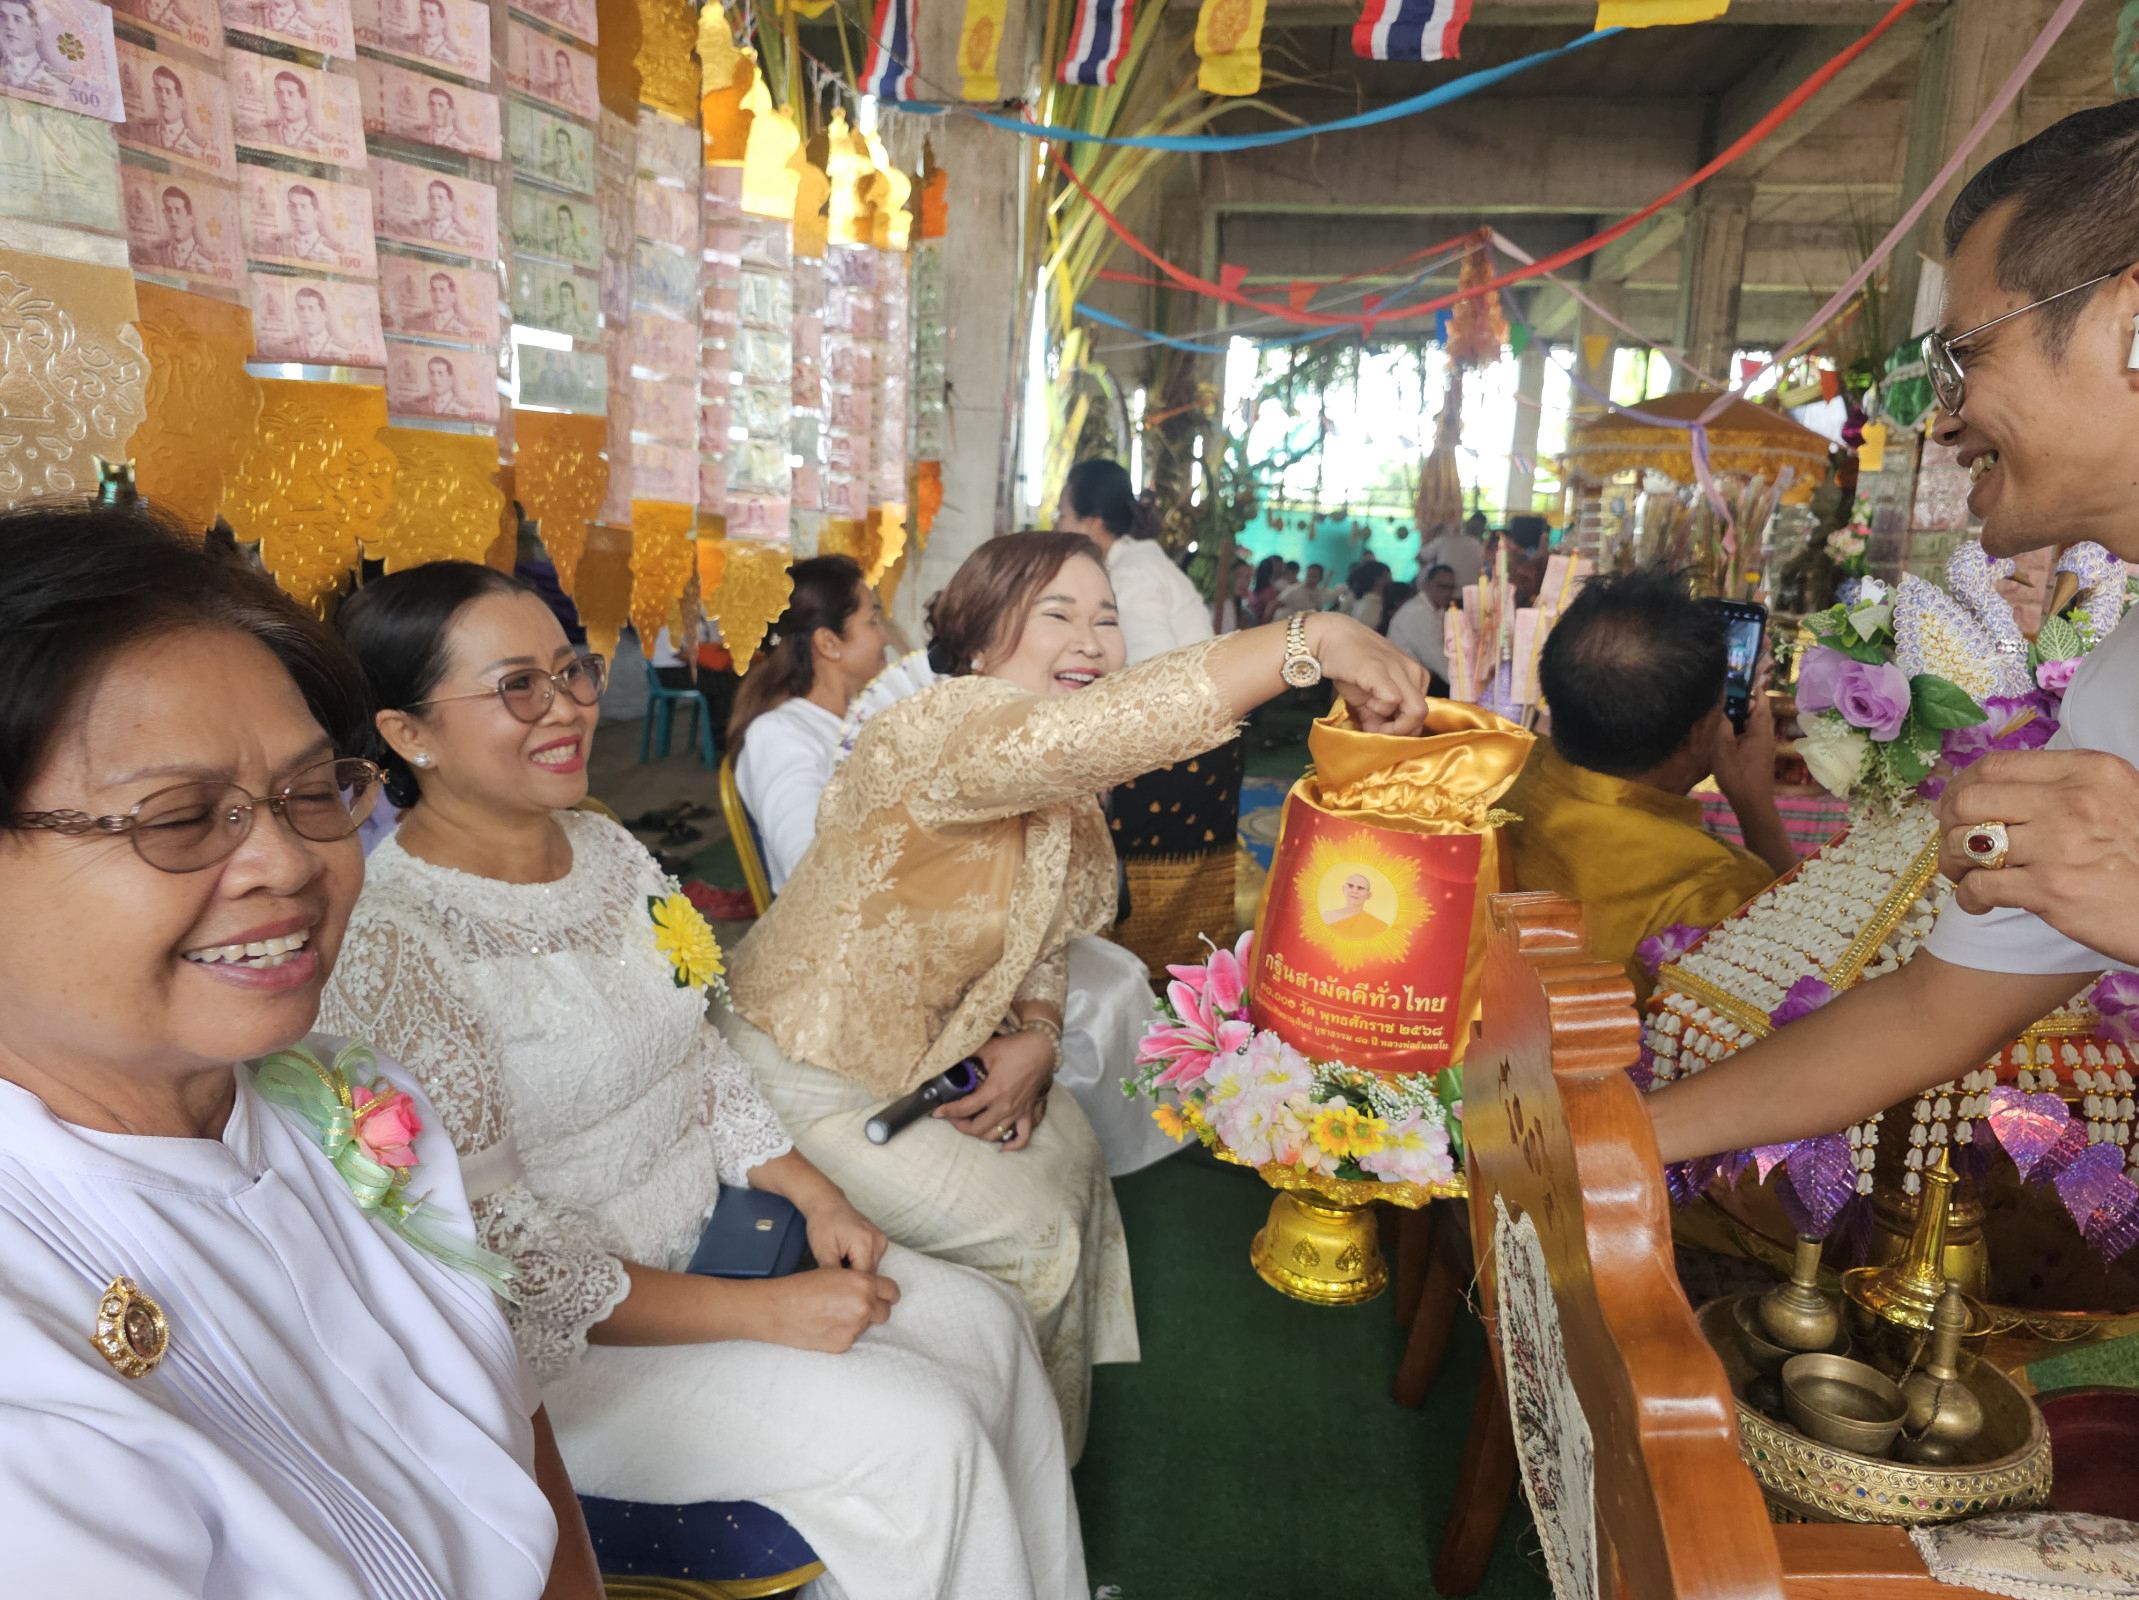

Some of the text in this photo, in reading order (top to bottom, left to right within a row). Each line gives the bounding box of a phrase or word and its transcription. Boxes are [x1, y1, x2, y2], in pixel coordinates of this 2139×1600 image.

[187, 29, 209, 47] 100
[314, 33, 338, 48] 100
[200, 151, 221, 168] 100
[338, 255, 360, 268] 100
[211, 265, 232, 280] 100
[348, 353, 370, 364] 100
[1265, 952, 1446, 1013] กฐินสามัคคีทั่วไทย
[1299, 1000, 1315, 1017] วัด
[1320, 1010, 1395, 1034] พุทธศักราช
[1399, 1023, 1444, 1036] ๒๕๖๘
